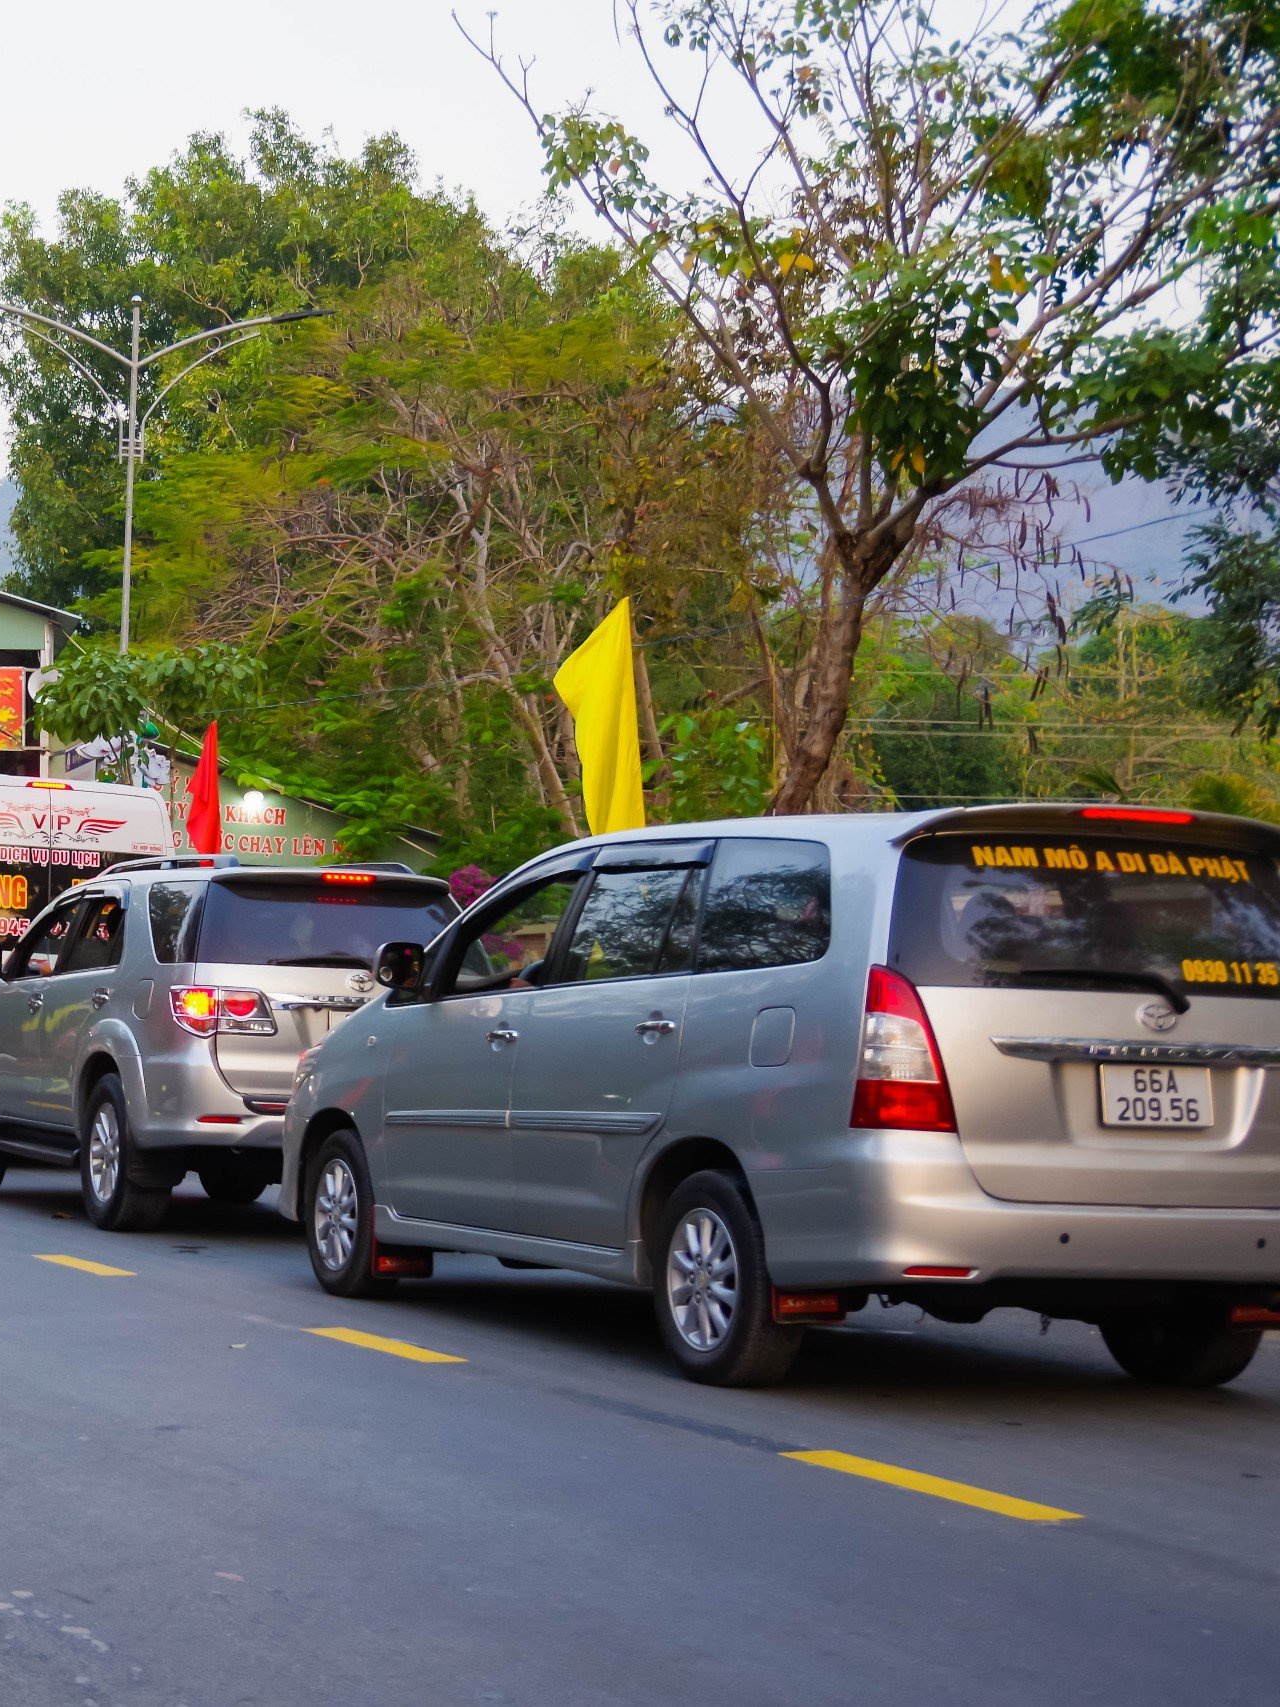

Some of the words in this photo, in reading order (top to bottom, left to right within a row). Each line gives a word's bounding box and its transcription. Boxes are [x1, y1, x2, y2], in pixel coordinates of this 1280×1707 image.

[31, 813, 71, 832] VIP
[237, 831, 288, 858] CHẠY
[291, 833, 326, 857] LÊN
[31, 847, 50, 868] VỤ
[51, 849, 71, 866] DU
[72, 850, 101, 869] LỊCH
[972, 846, 1039, 867] NAM
[1043, 844, 1089, 870] MÔ
[1095, 851, 1115, 872] A
[1117, 852, 1147, 873] DI
[1149, 851, 1187, 876] ĐÀ
[1188, 855, 1250, 884] PHẬT
[1230, 961, 1252, 984] 11
[1254, 962, 1279, 986] 35
[1134, 1069, 1178, 1094] 66A
[1117, 1097, 1200, 1123] 209.56
